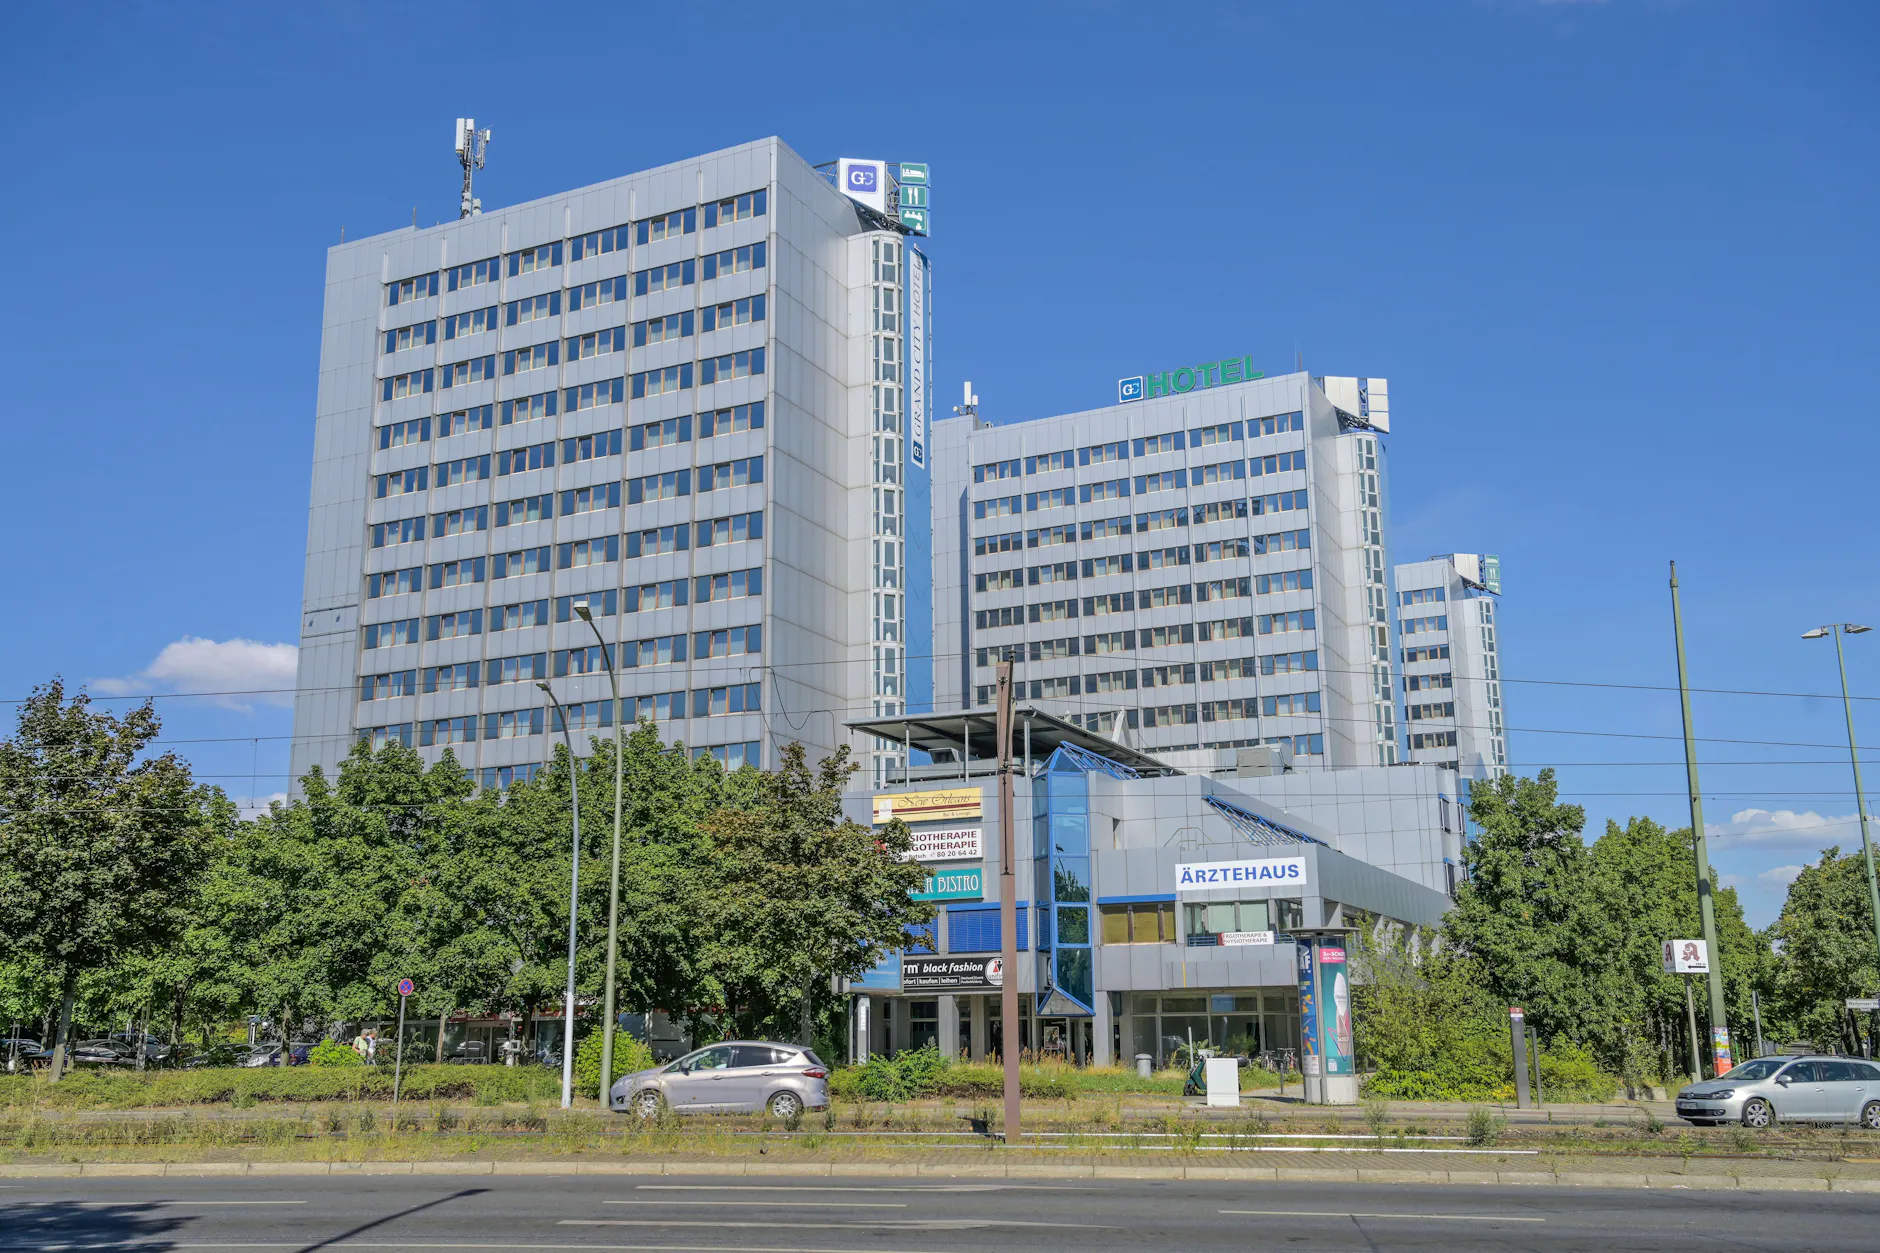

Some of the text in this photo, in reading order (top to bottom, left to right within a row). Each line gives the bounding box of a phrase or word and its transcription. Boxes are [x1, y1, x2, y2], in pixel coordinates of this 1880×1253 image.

[914, 319, 922, 364] CITY
[1145, 355, 1265, 399] HOTEL
[914, 368, 922, 437] GRAND
[898, 792, 972, 808] New Orleans
[910, 830, 977, 842] SIOTHERAPIE
[911, 840, 977, 852] GOTHERAPIE
[1180, 864, 1300, 884] ÄRZTEHAUS
[937, 874, 979, 893] BISTRO
[922, 962, 948, 973] black
[948, 961, 983, 974] fashion
[919, 977, 939, 985] kaufen
